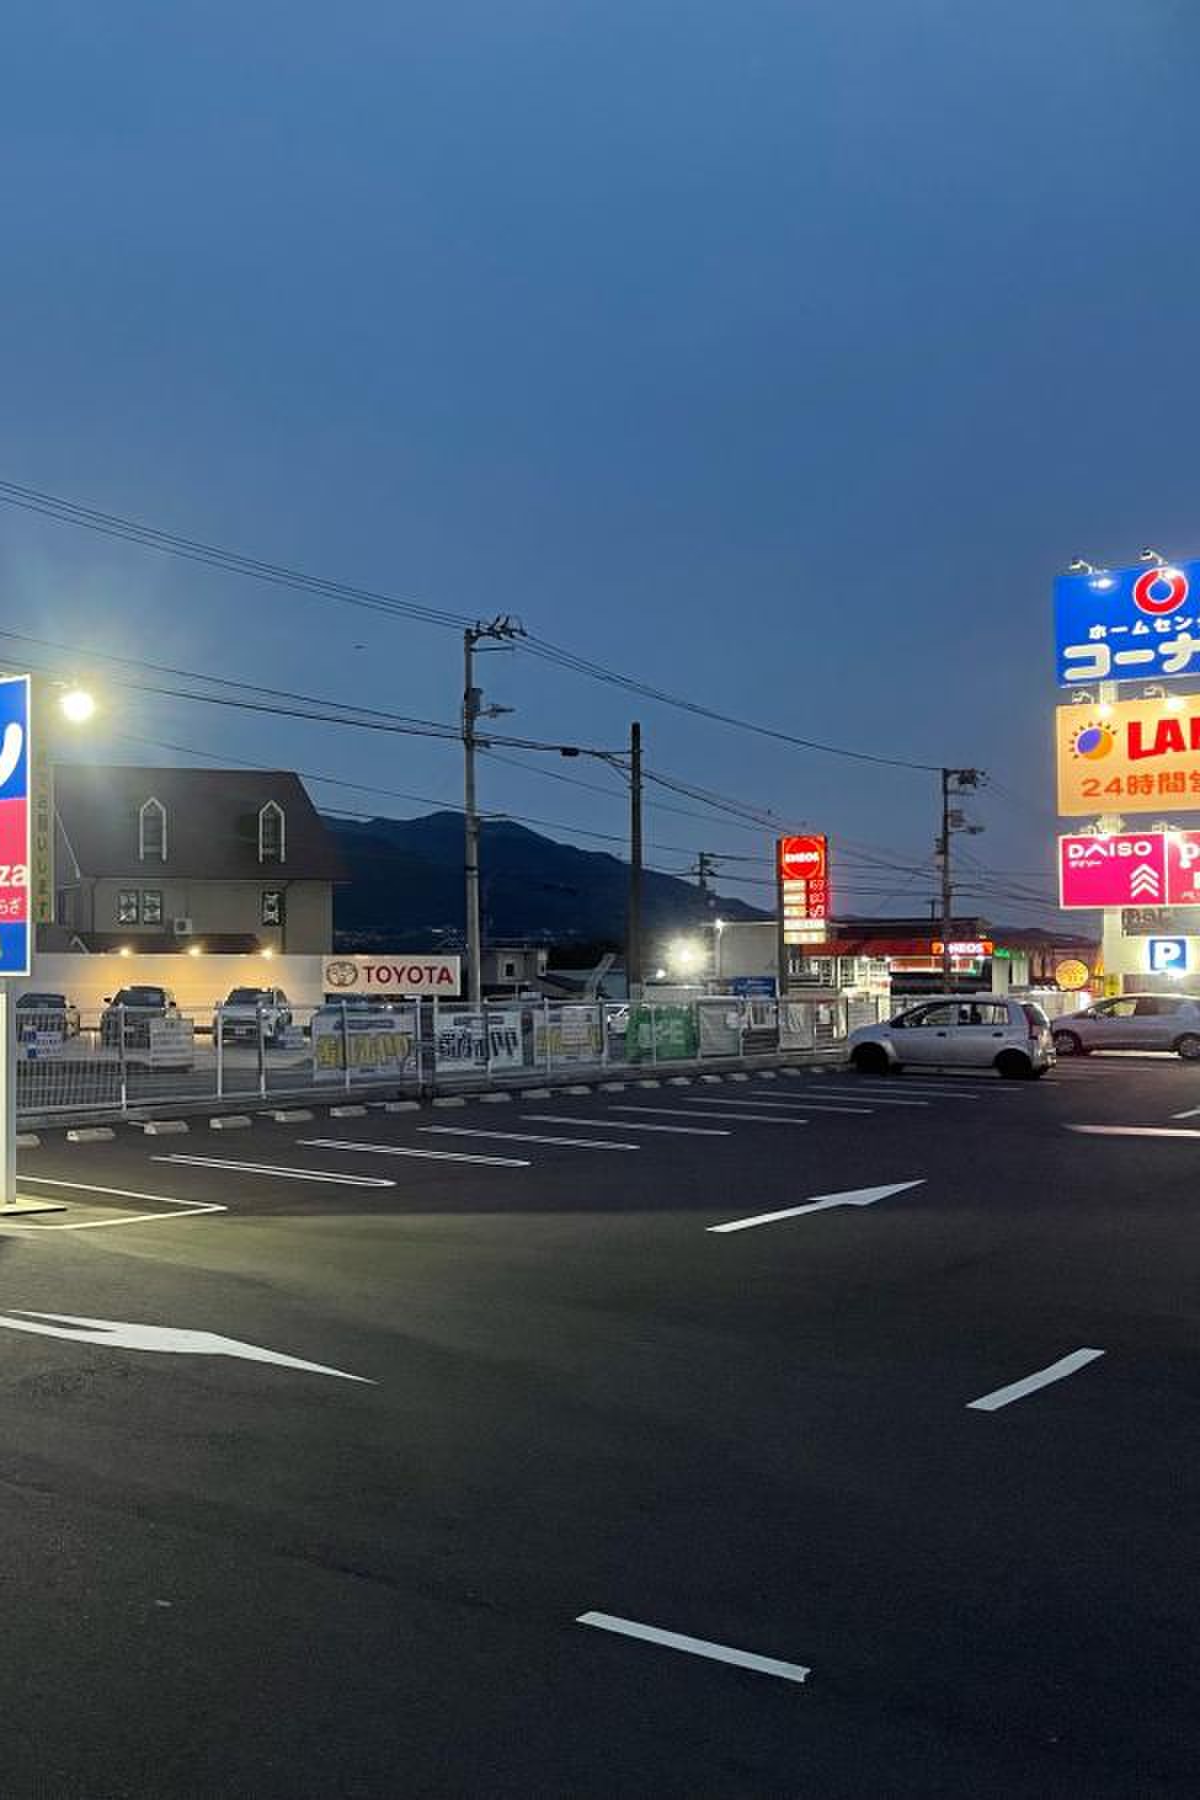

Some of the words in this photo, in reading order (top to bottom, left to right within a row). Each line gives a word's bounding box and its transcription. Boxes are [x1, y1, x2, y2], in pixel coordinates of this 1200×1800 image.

[1088, 616, 1200, 640] ホームセン
[1068, 841, 1153, 859] DAISO
[362, 965, 454, 985] TOYOTA
